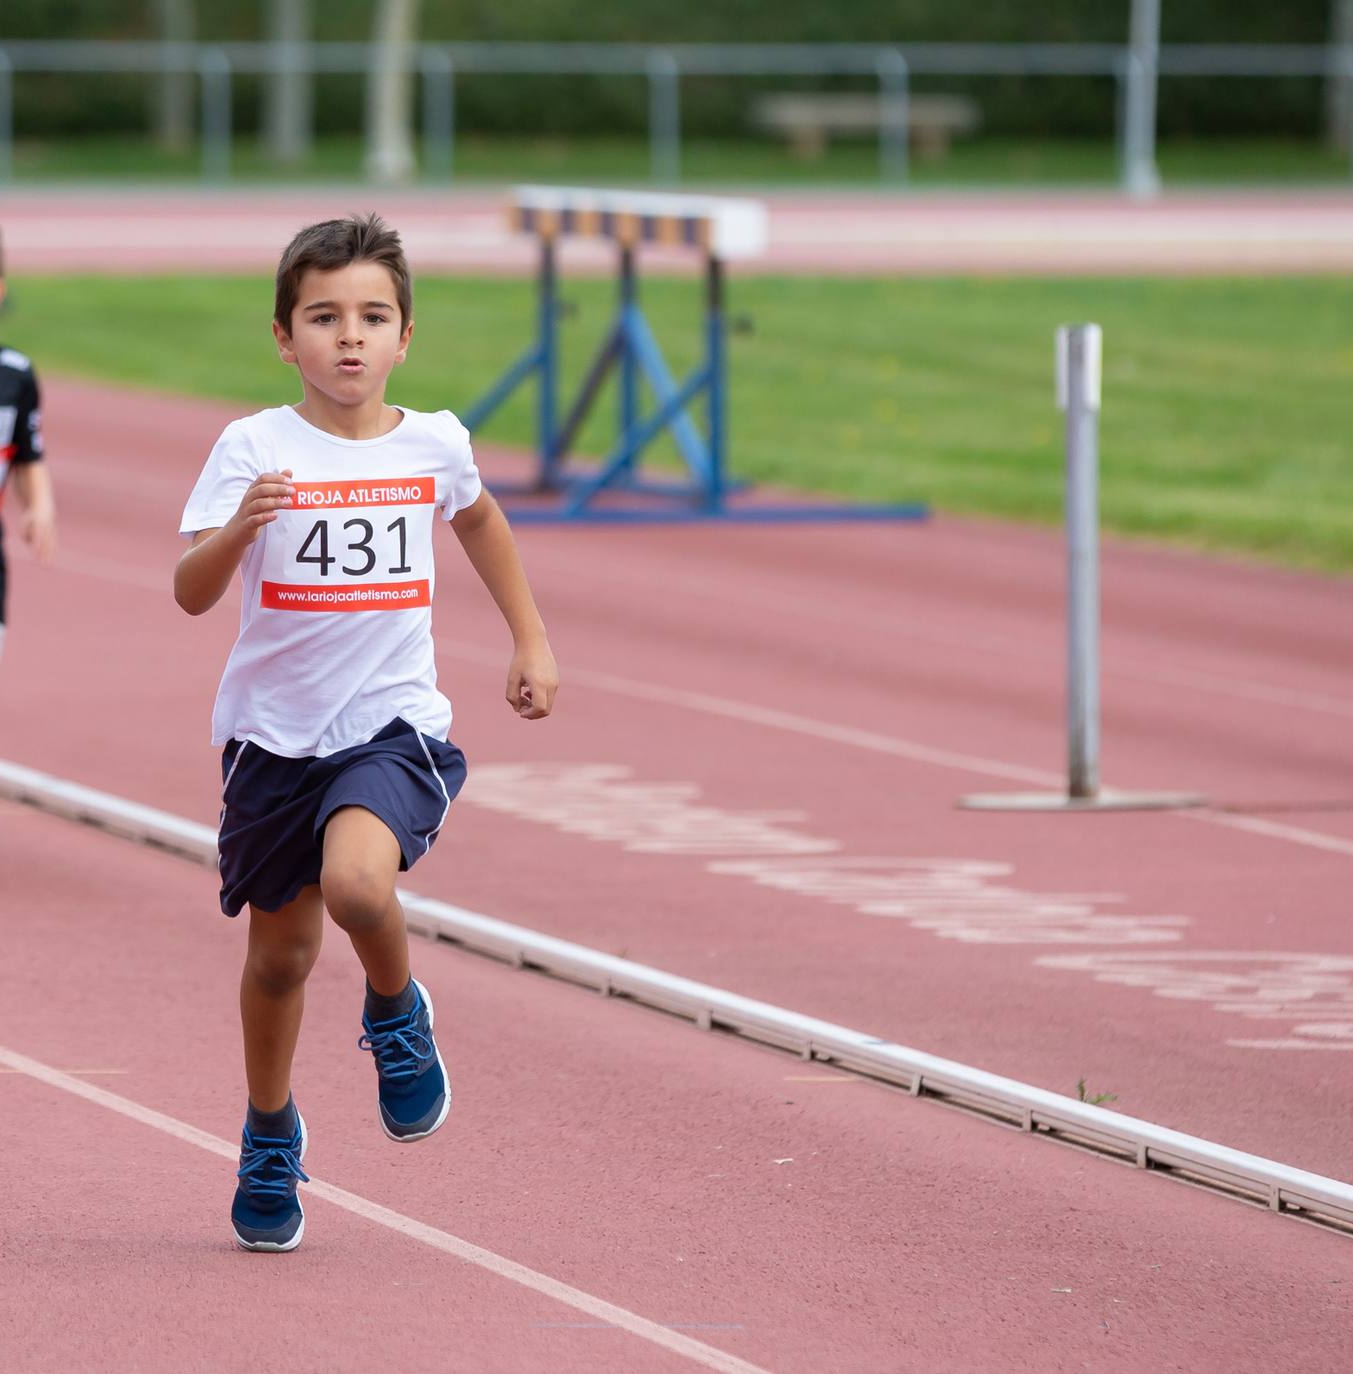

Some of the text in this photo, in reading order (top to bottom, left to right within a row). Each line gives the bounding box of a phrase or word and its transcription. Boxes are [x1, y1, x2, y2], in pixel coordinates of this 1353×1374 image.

[297, 491, 344, 505] RIOJA
[347, 486, 422, 503] ATLETISMO
[295, 516, 412, 576] 431
[277, 588, 419, 604] www.lariojaatletismo.com
